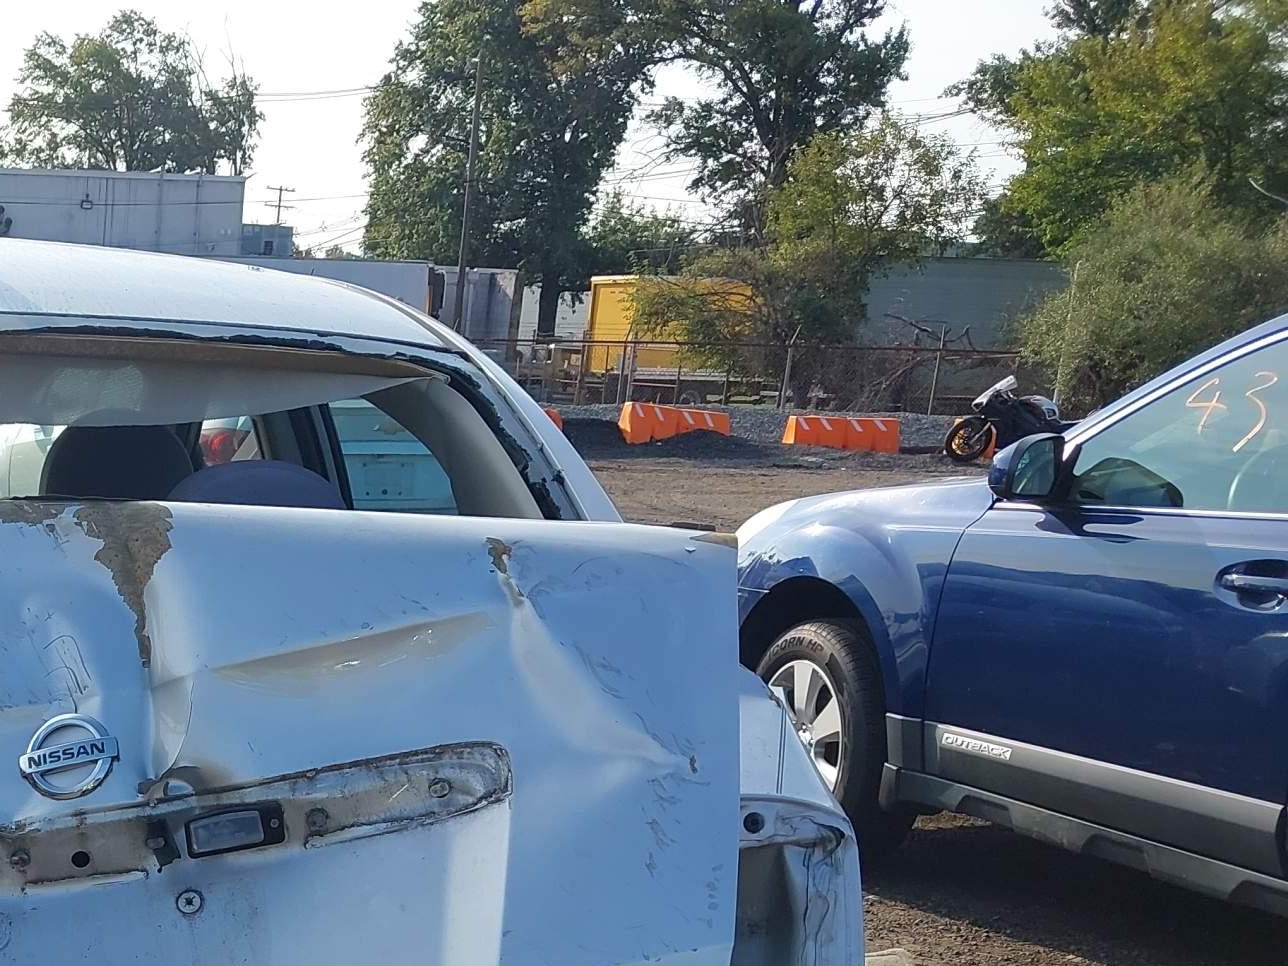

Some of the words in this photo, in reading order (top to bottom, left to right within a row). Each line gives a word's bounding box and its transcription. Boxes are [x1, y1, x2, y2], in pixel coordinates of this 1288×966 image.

[1185, 371, 1278, 453] 43
[807, 638, 825, 653] HP
[27, 741, 106, 769] NISSAN
[943, 734, 1011, 760] OUTBACK
